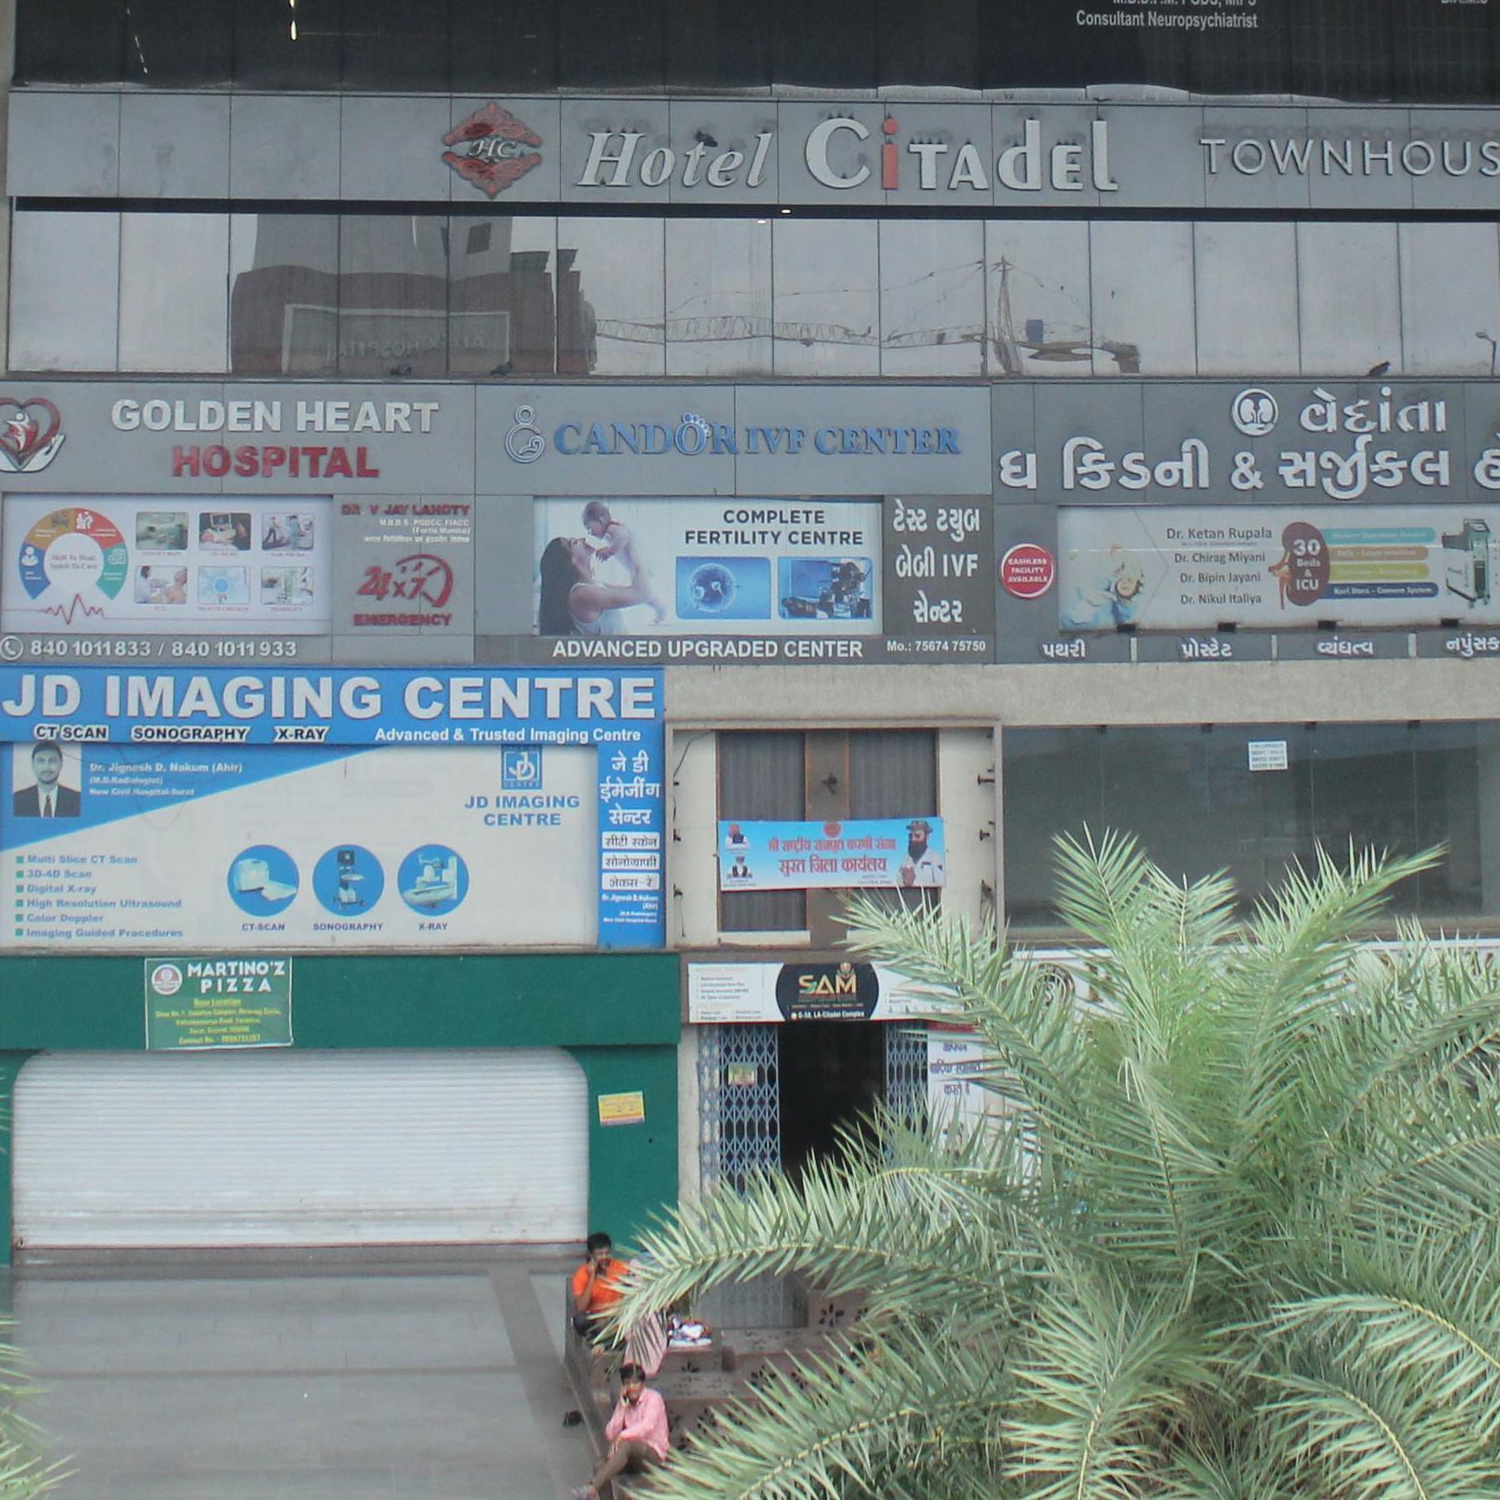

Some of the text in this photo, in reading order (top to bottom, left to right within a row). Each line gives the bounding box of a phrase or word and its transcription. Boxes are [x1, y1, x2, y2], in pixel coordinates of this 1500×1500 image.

[1076, 10, 1258, 31] Consultant Neuropsychiatrist
[577, 129, 768, 189] Hotel
[111, 400, 439, 433] GOLDEN HEART
[555, 413, 961, 457] CANDOR IVF CENTER
[172, 446, 379, 477] HOSPITAL
[1062, 437, 1210, 489] કિડની
[1232, 455, 1263, 490] &
[723, 510, 825, 524] COMPLETE
[685, 530, 863, 546] FERTILITY CENTRE
[1167, 528, 1272, 540] Dr. Ketan Rupala
[1293, 539, 1320, 556] 30
[895, 545, 979, 578] બેબી IVF
[1174, 552, 1265, 565] Dr. Chirag Miyani
[1297, 558, 1320, 568] Beds
[1180, 572, 1260, 584] Dr. Bipin Jayani
[1296, 579, 1319, 590] ICU
[1180, 594, 1194, 604] Dr.
[913, 590, 964, 624] સેન્ટર
[354, 614, 452, 626] EMERGENCY
[30, 640, 67, 656] 840
[172, 641, 209, 656] 840
[552, 640, 863, 659] ADVANCED UPGRADED CENTER
[916, 641, 950, 653] 75674
[952, 641, 986, 653] 75750
[1043, 636, 1085, 661] પથરી
[2, 674, 657, 721] JD IMAGING CENTRE
[33, 726, 109, 740] CT SCAN
[131, 726, 250, 743] SONOGRAPHY
[273, 726, 329, 742] X-RAY
[375, 727, 641, 745] Advanced & Trusted Imaging Centre
[89, 763, 106, 772] Dr.
[155, 763, 167, 772] D.
[169, 763, 209, 772] Nakum
[212, 762, 243, 774] (Ahir)
[612, 750, 649, 773] जे डी
[465, 796, 580, 808] JD IMAGING
[484, 813, 561, 826] CENTRE
[609, 803, 652, 825] सेन्टर
[27, 855, 137, 864] Multi Slice CT Scan
[27, 870, 92, 878] 3D-4D Scan
[27, 884, 96, 894] Digital X-ray
[27, 899, 182, 909] High Resolution Ultrasound
[27, 914, 103, 924] Color Doppler
[313, 921, 384, 932] SONOGRAPHY
[417, 921, 449, 931] X-RAY
[27, 929, 183, 939] Imaging Guided Procedures
[241, 922, 286, 932] CT-SCAN
[187, 961, 285, 977] MARTINO'Z
[201, 978, 271, 994] PIZZA
[798, 974, 857, 995] SAM
